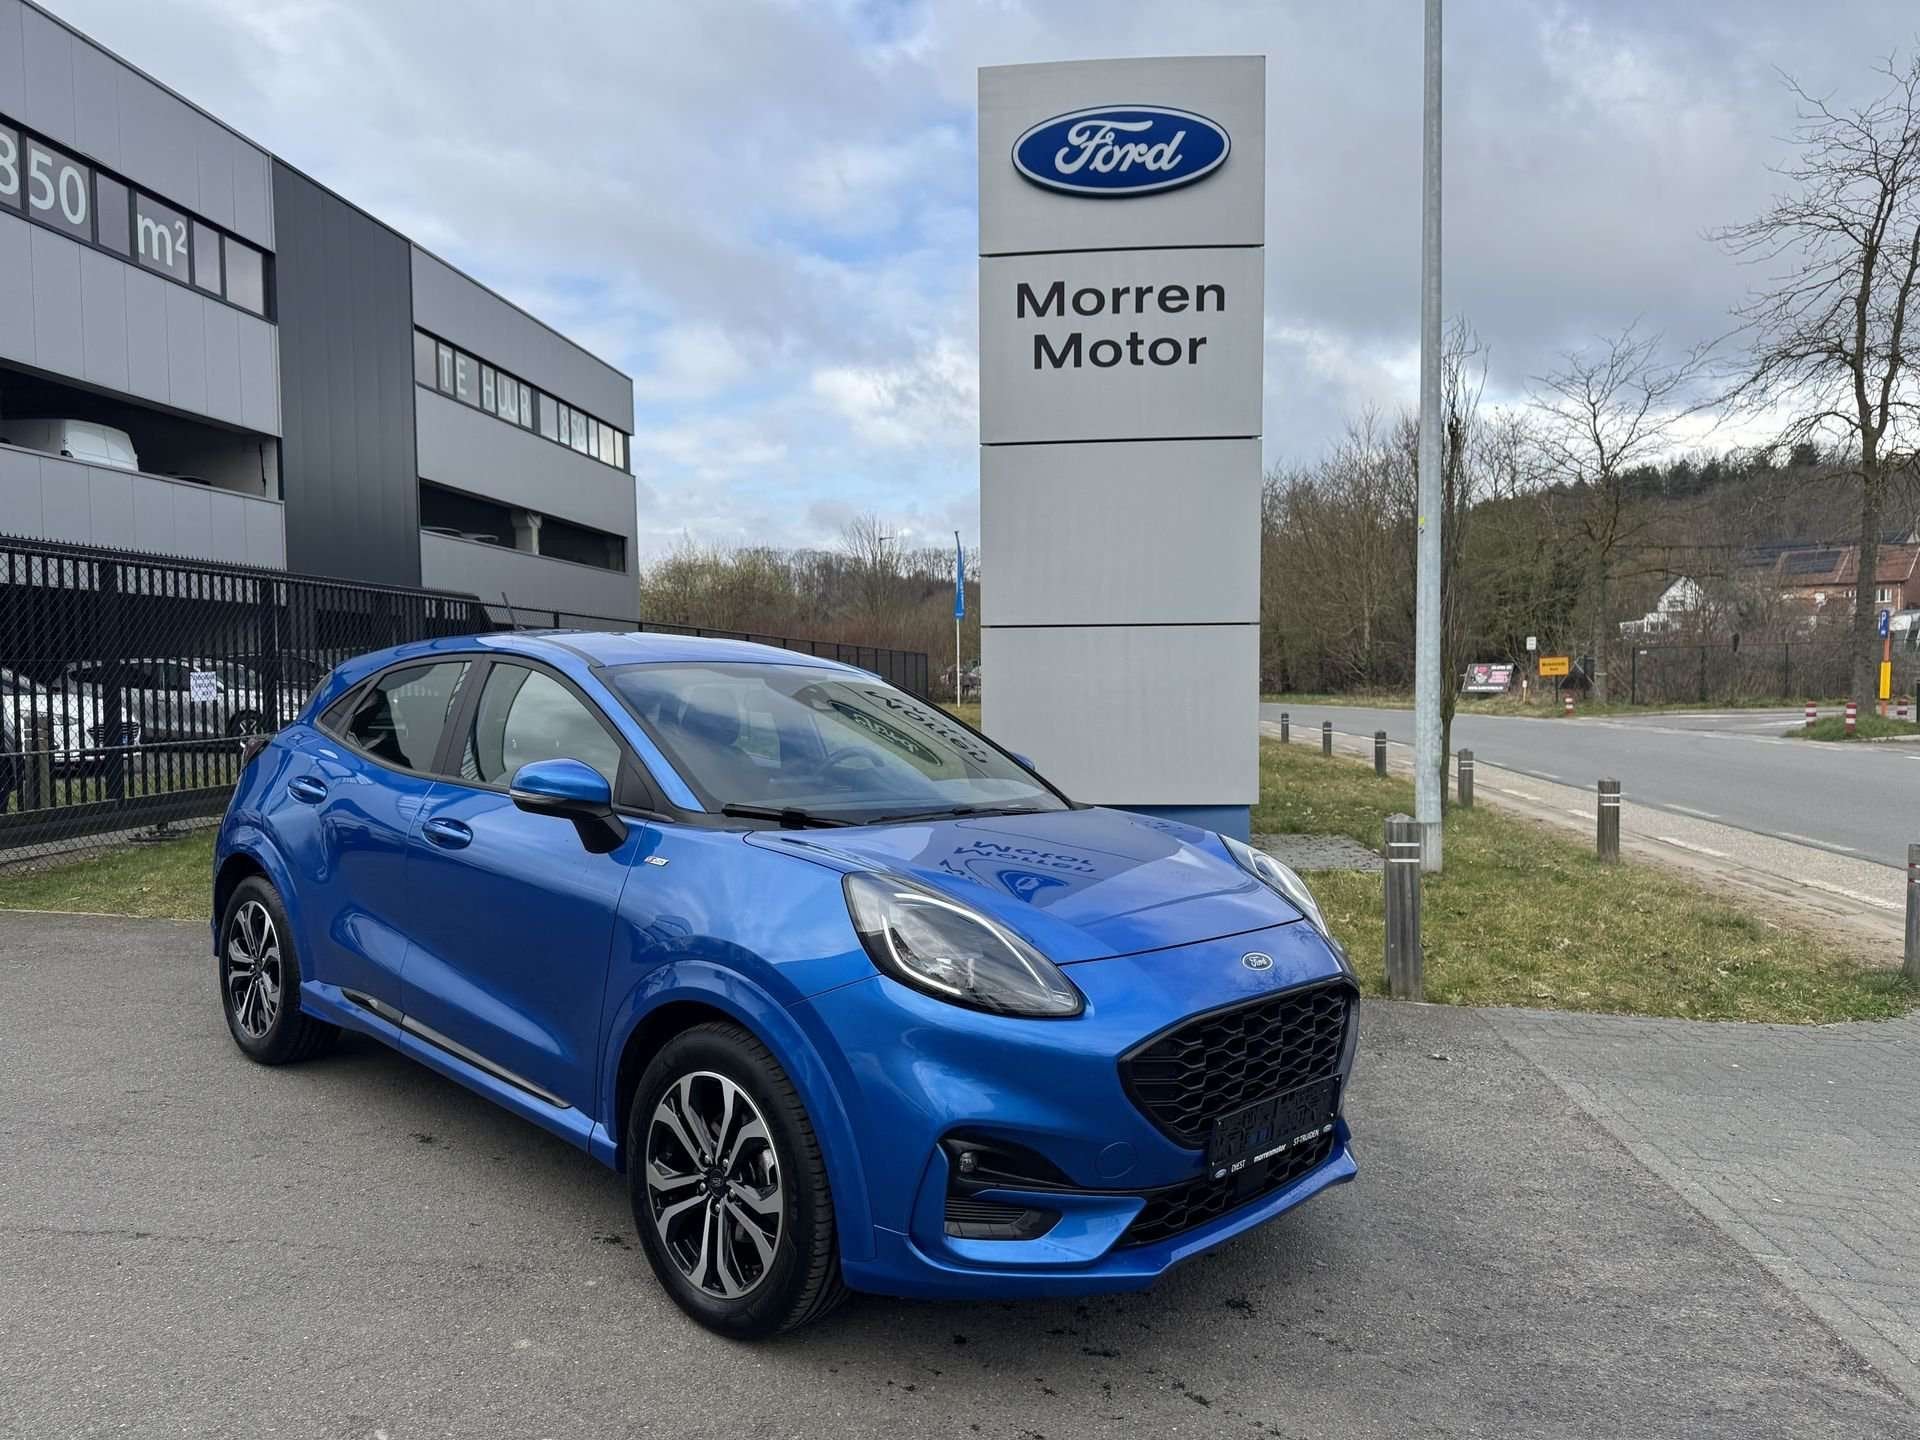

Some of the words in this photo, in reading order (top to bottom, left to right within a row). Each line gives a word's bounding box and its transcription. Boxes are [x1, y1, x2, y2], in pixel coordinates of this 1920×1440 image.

[1054, 119, 1187, 174] Ford
[1016, 281, 1226, 319] Morren
[1033, 331, 1208, 370] Motor
[439, 348, 468, 396] TE
[482, 364, 530, 419] HUUR
[1881, 611, 1887, 625] P
